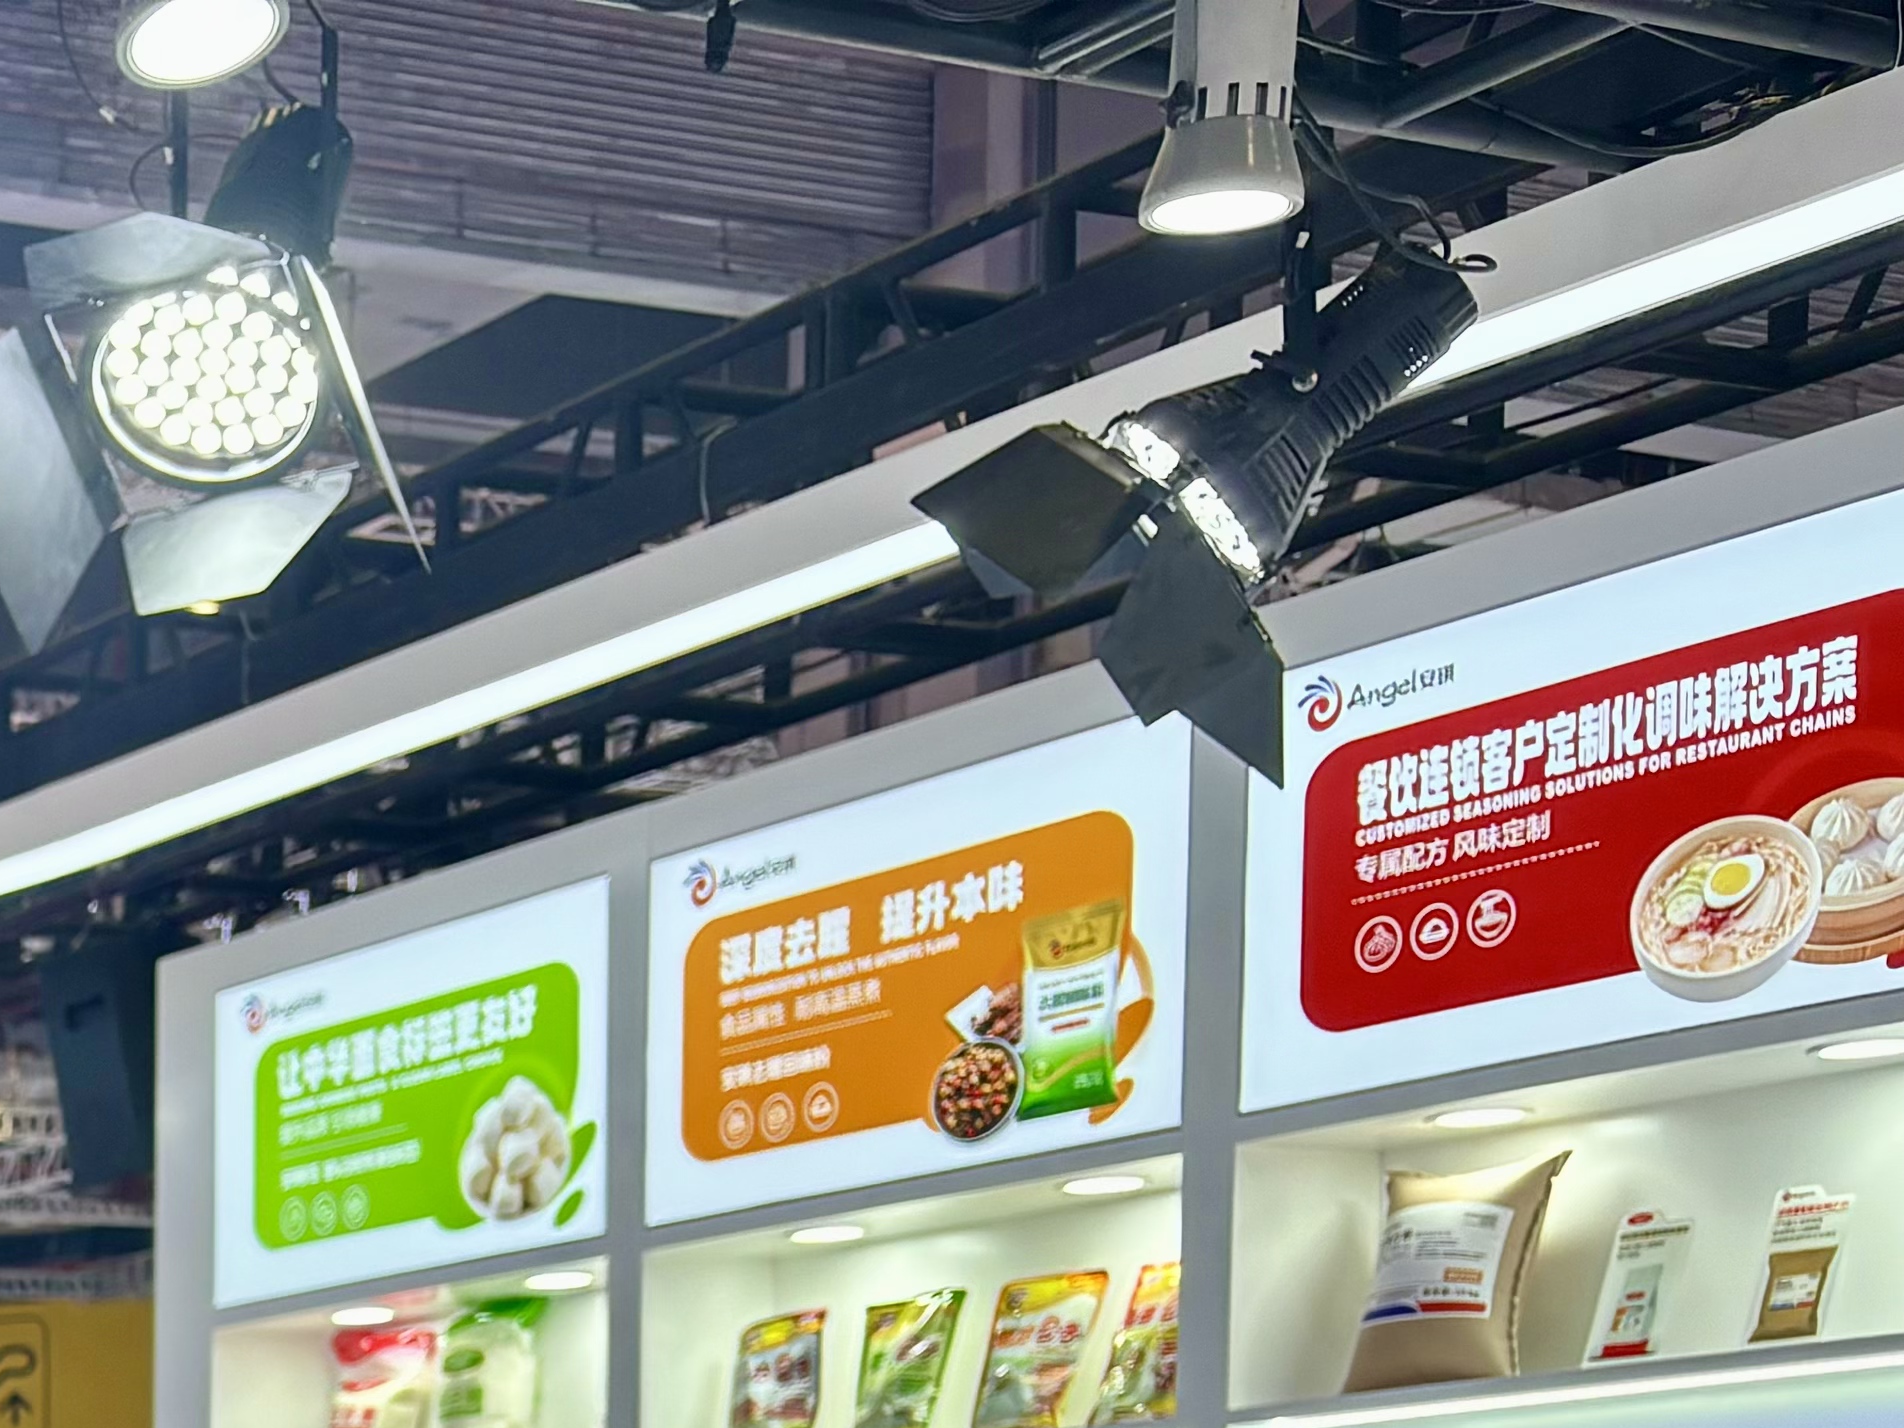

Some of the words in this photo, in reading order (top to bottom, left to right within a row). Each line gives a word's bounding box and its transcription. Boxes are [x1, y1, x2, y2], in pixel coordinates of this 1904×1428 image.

[1347, 668, 1416, 709] Angel
[1356, 634, 1858, 827] 餐饮连锁客户定制化调味解决方案
[1355, 809, 1451, 848] CUSTOMIZED
[1453, 785, 1542, 823] SEASONING
[1544, 760, 1635, 800] SOLUTIONS
[1638, 750, 1672, 776] FOR
[1675, 722, 1785, 766] RESTAURANT
[1790, 704, 1857, 738] CHAINS
[1354, 837, 1450, 884] 专属配方
[1452, 809, 1552, 862] 风味定制
